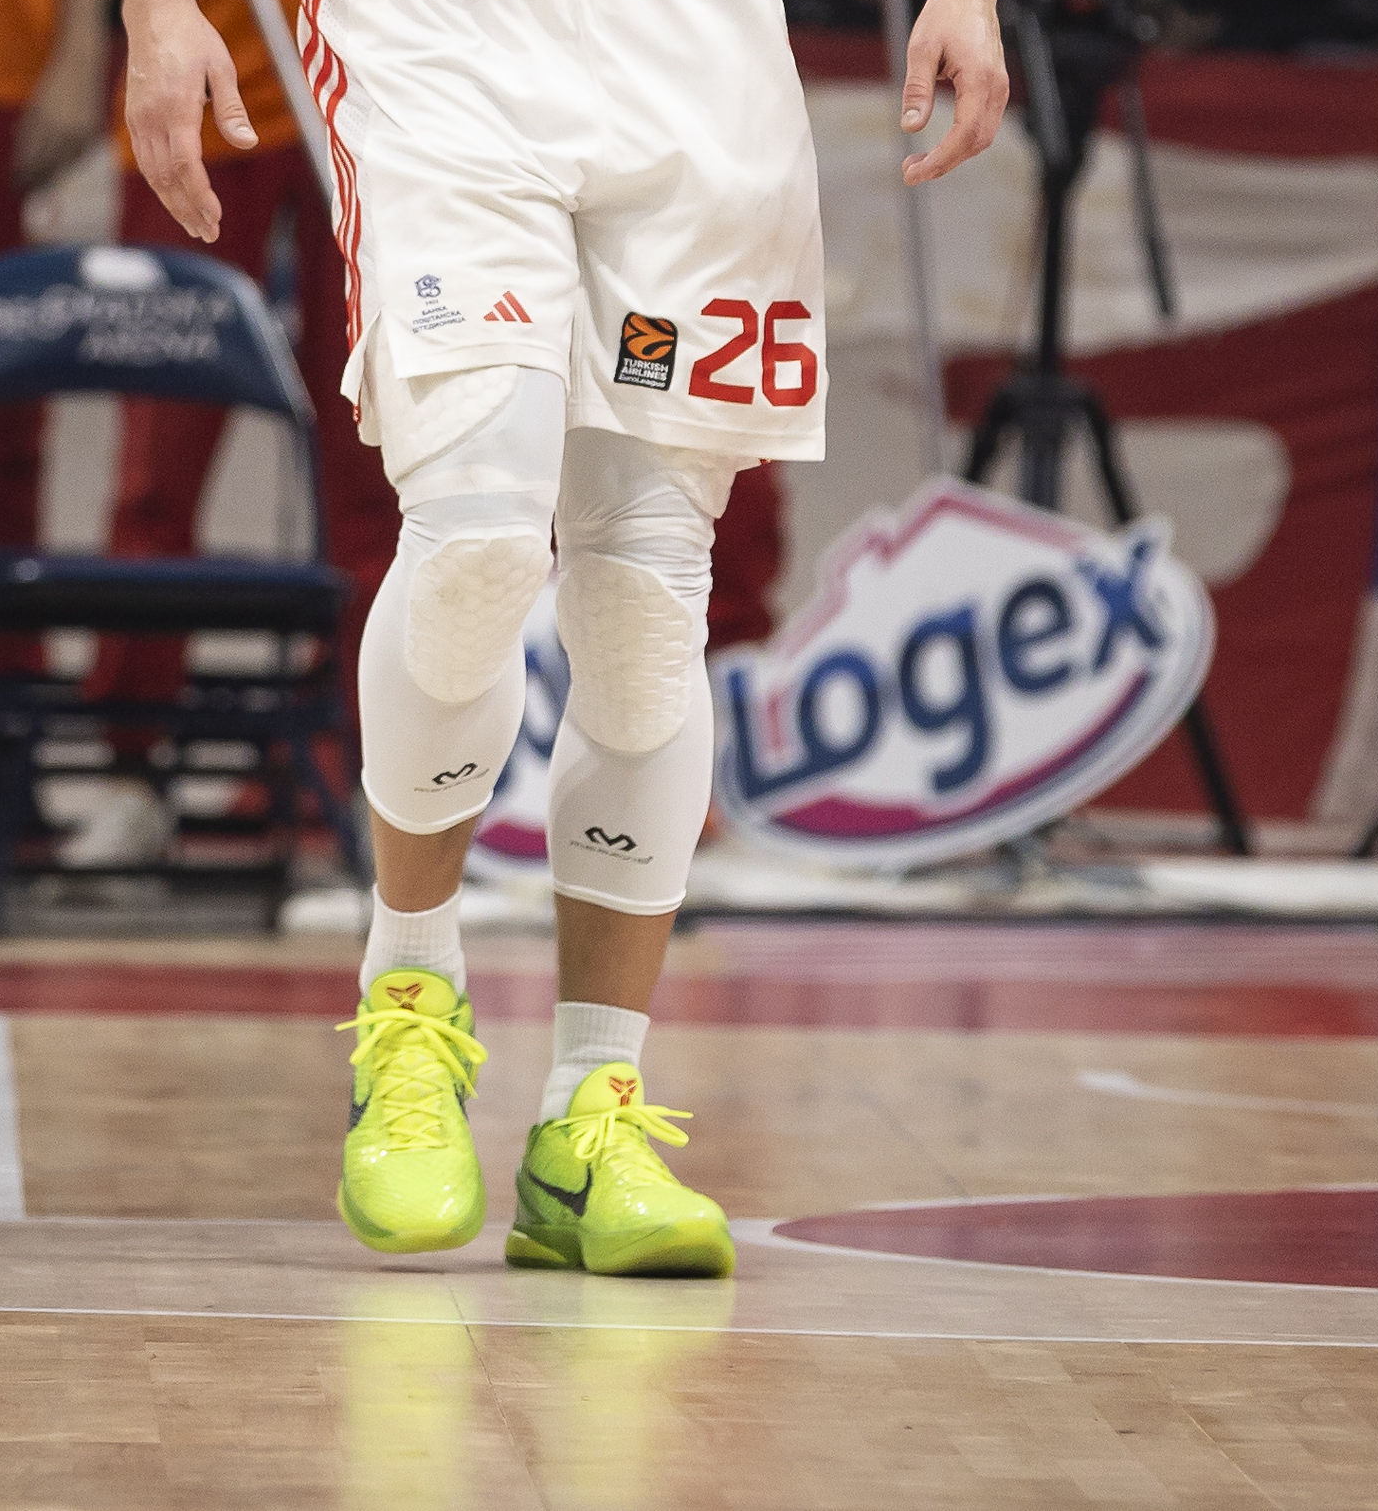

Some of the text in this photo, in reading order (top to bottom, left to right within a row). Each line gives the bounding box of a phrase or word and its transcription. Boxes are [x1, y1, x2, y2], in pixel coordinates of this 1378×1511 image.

[621, 366, 668, 381] AIRLINES
[623, 357, 669, 373] TURKISH
[688, 297, 818, 407] 26
[728, 539, 1165, 802] Logex
